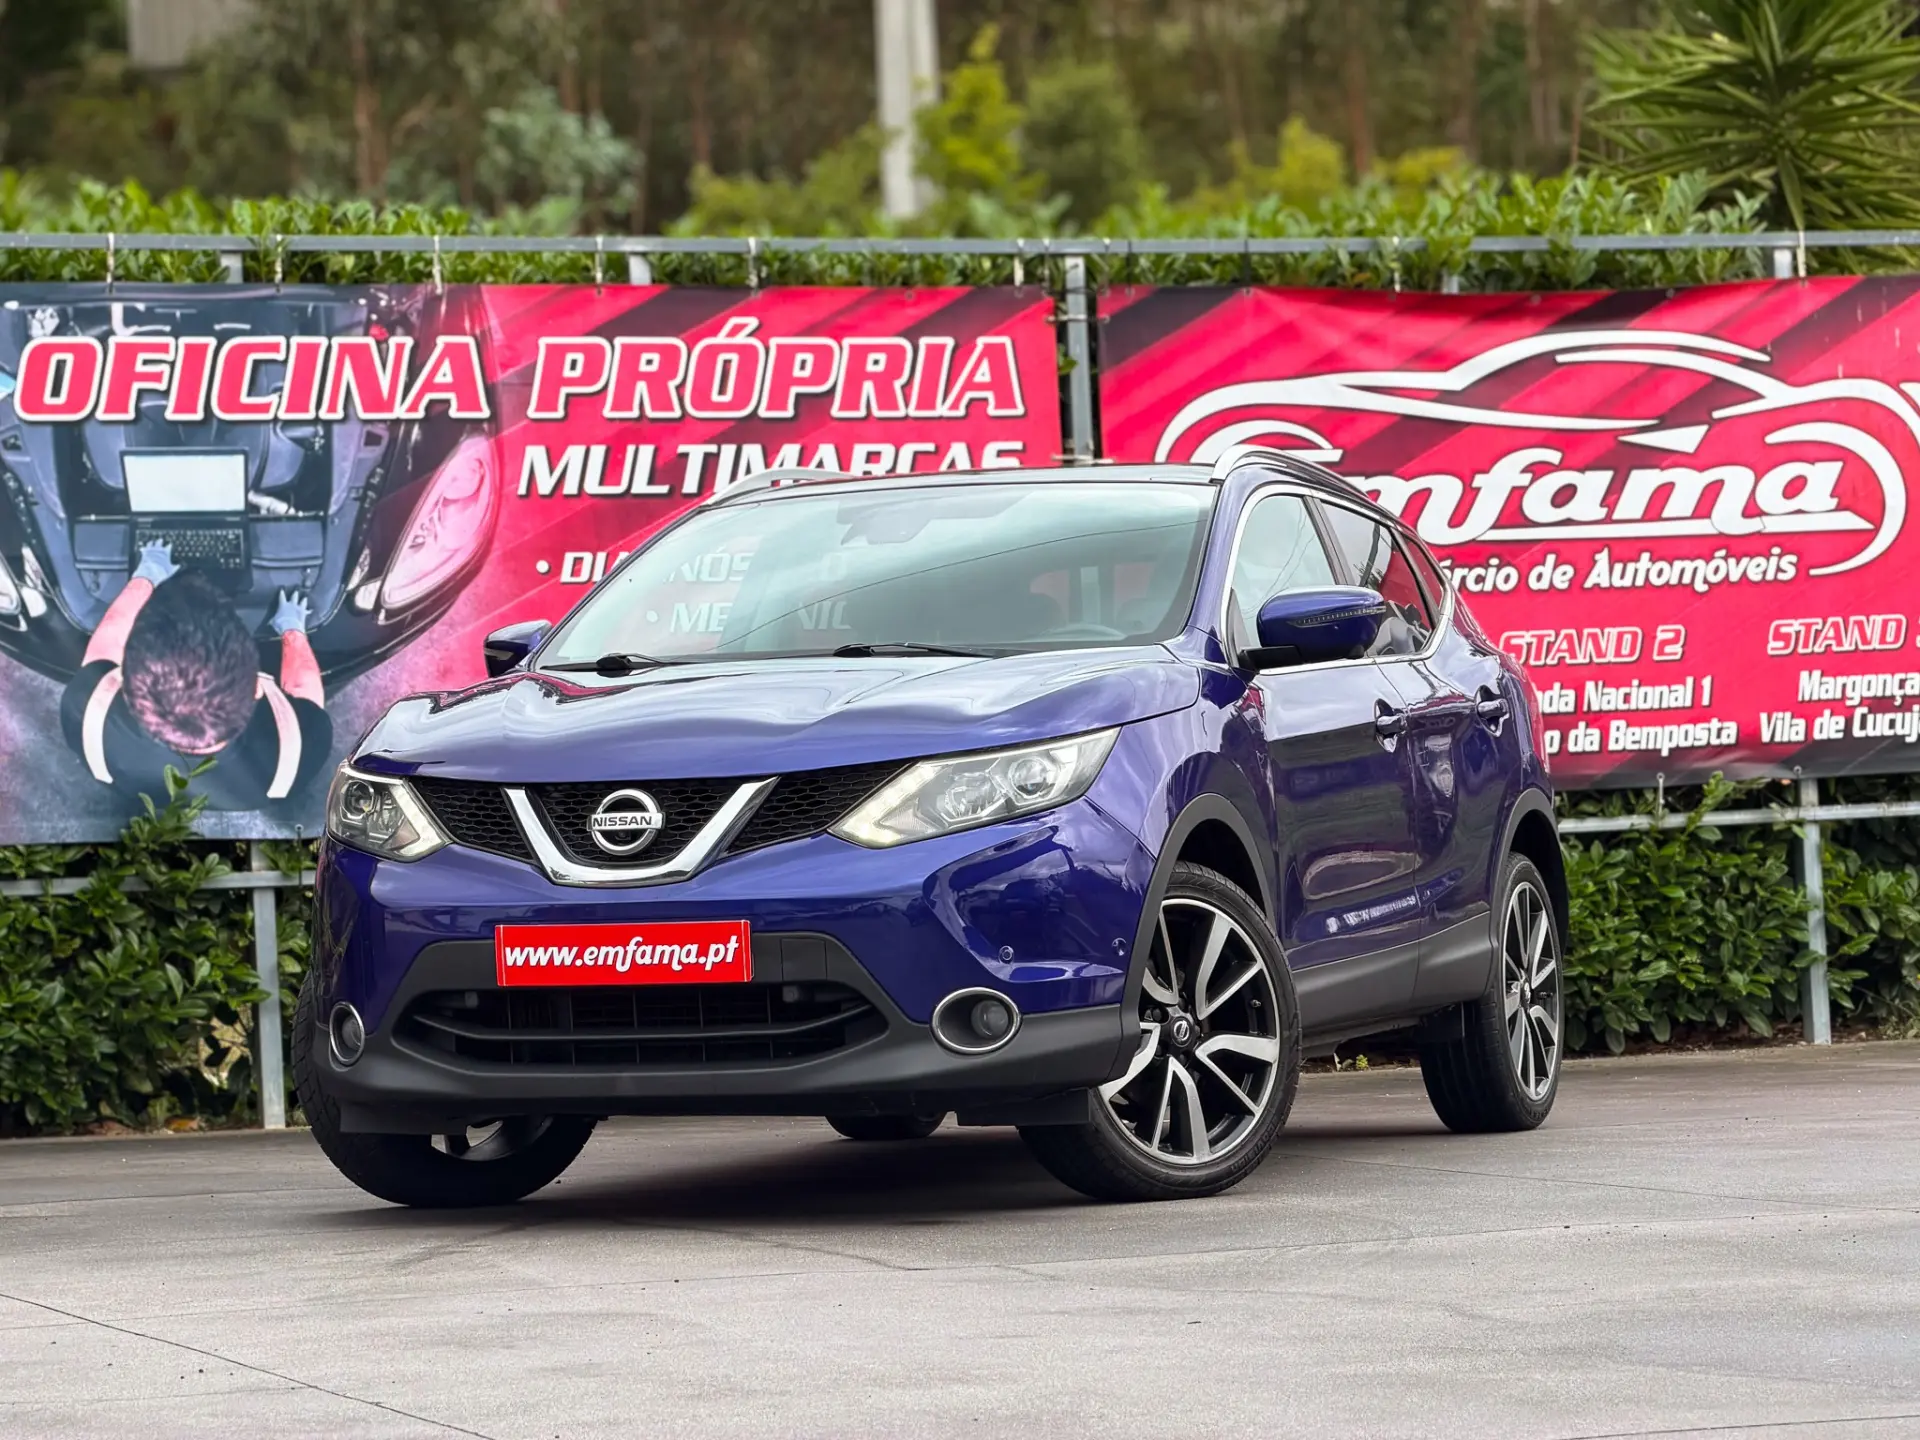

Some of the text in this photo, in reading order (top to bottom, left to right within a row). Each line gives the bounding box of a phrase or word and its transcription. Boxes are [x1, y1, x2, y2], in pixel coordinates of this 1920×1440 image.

[14, 316, 1026, 422] OFICINA PRÓPRIA
[1190, 419, 1844, 545] mfama
[1527, 553, 1575, 592] de
[1583, 546, 1798, 594] Automóveis
[1499, 624, 1687, 667] STAND 2
[1767, 614, 1907, 656] STAND
[1582, 676, 1694, 712] Nacional
[1701, 675, 1713, 707] 1
[1798, 669, 1920, 706] Margonça
[1567, 721, 1600, 753] da
[1608, 717, 1738, 757] Bemposta
[1759, 704, 1920, 744] Vila de Cucuj
[592, 815, 654, 828] NISSAN
[505, 935, 740, 973] www.emfama.pt
